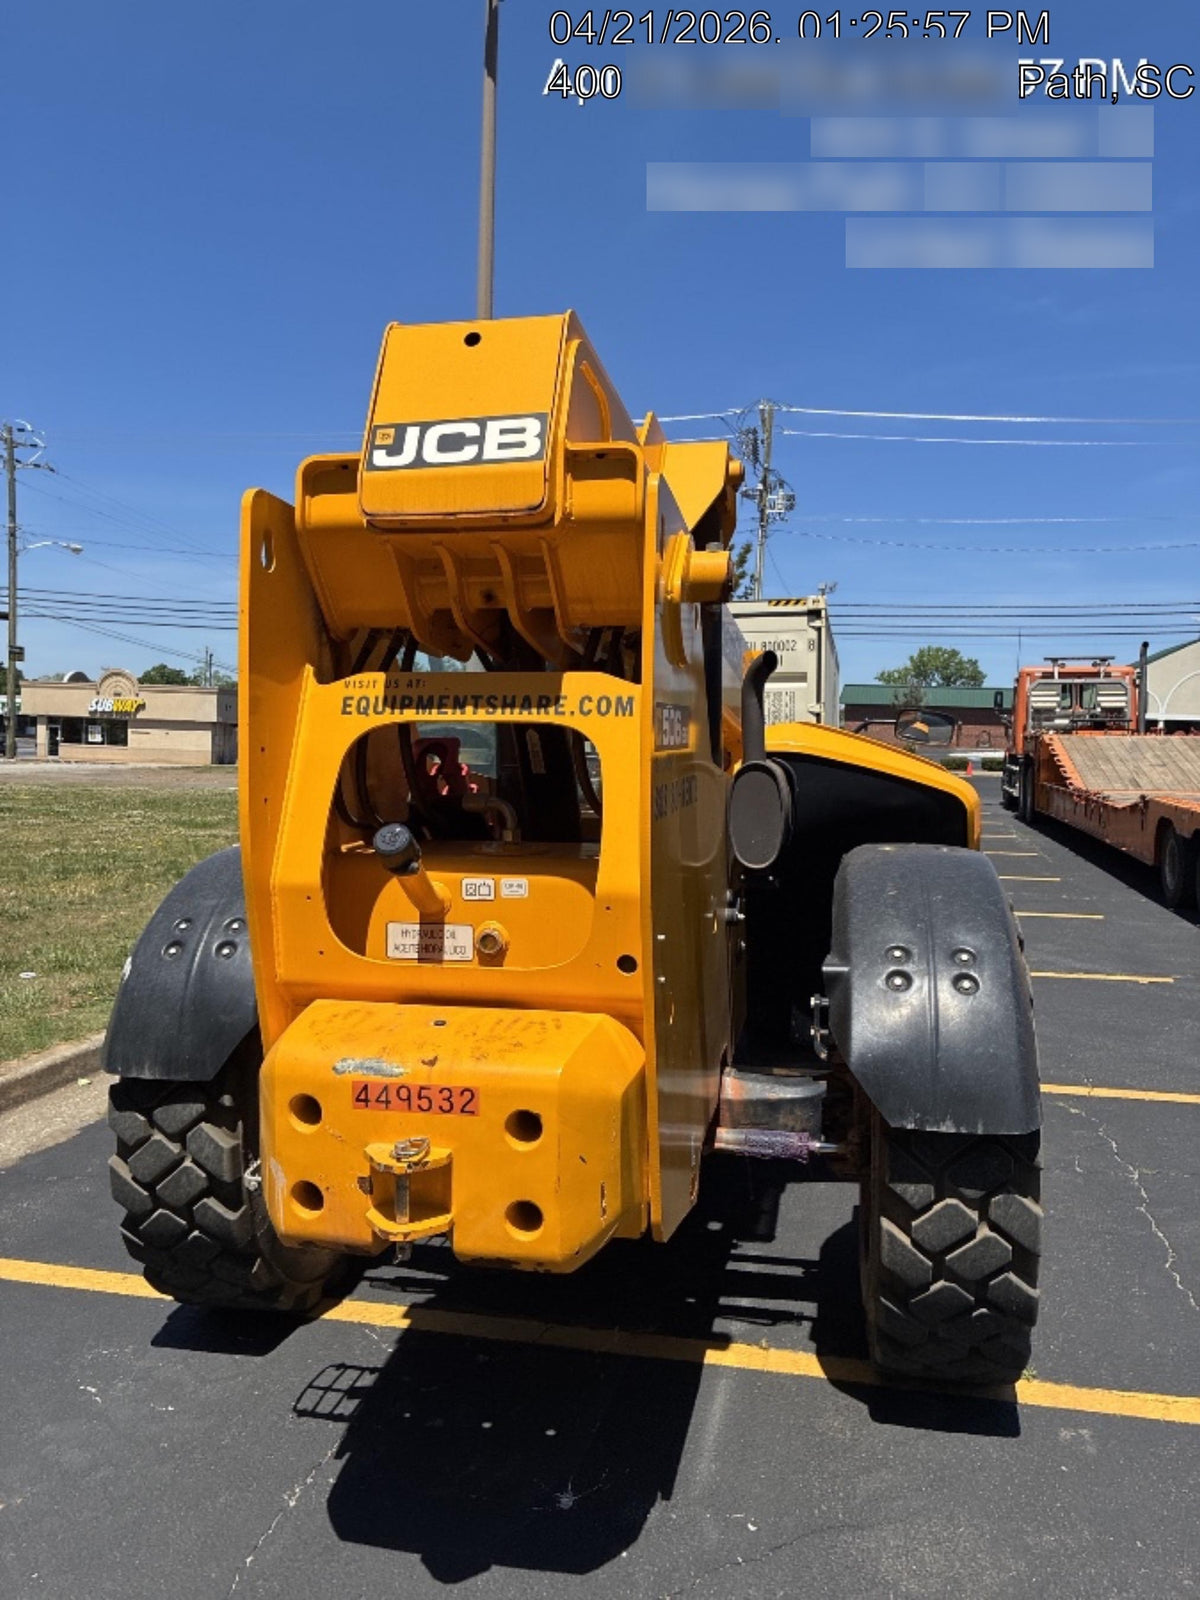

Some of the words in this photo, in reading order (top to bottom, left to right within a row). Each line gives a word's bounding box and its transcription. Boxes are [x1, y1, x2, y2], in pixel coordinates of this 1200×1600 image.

[373, 417, 541, 467] JCB
[344, 679, 378, 689] VISIT
[385, 679, 399, 689] US
[406, 679, 427, 689] AT:
[89, 697, 145, 712] SUBWAY
[341, 694, 635, 717] EQUIPMENTSHARE.COM
[354, 1083, 475, 1115] 449532
